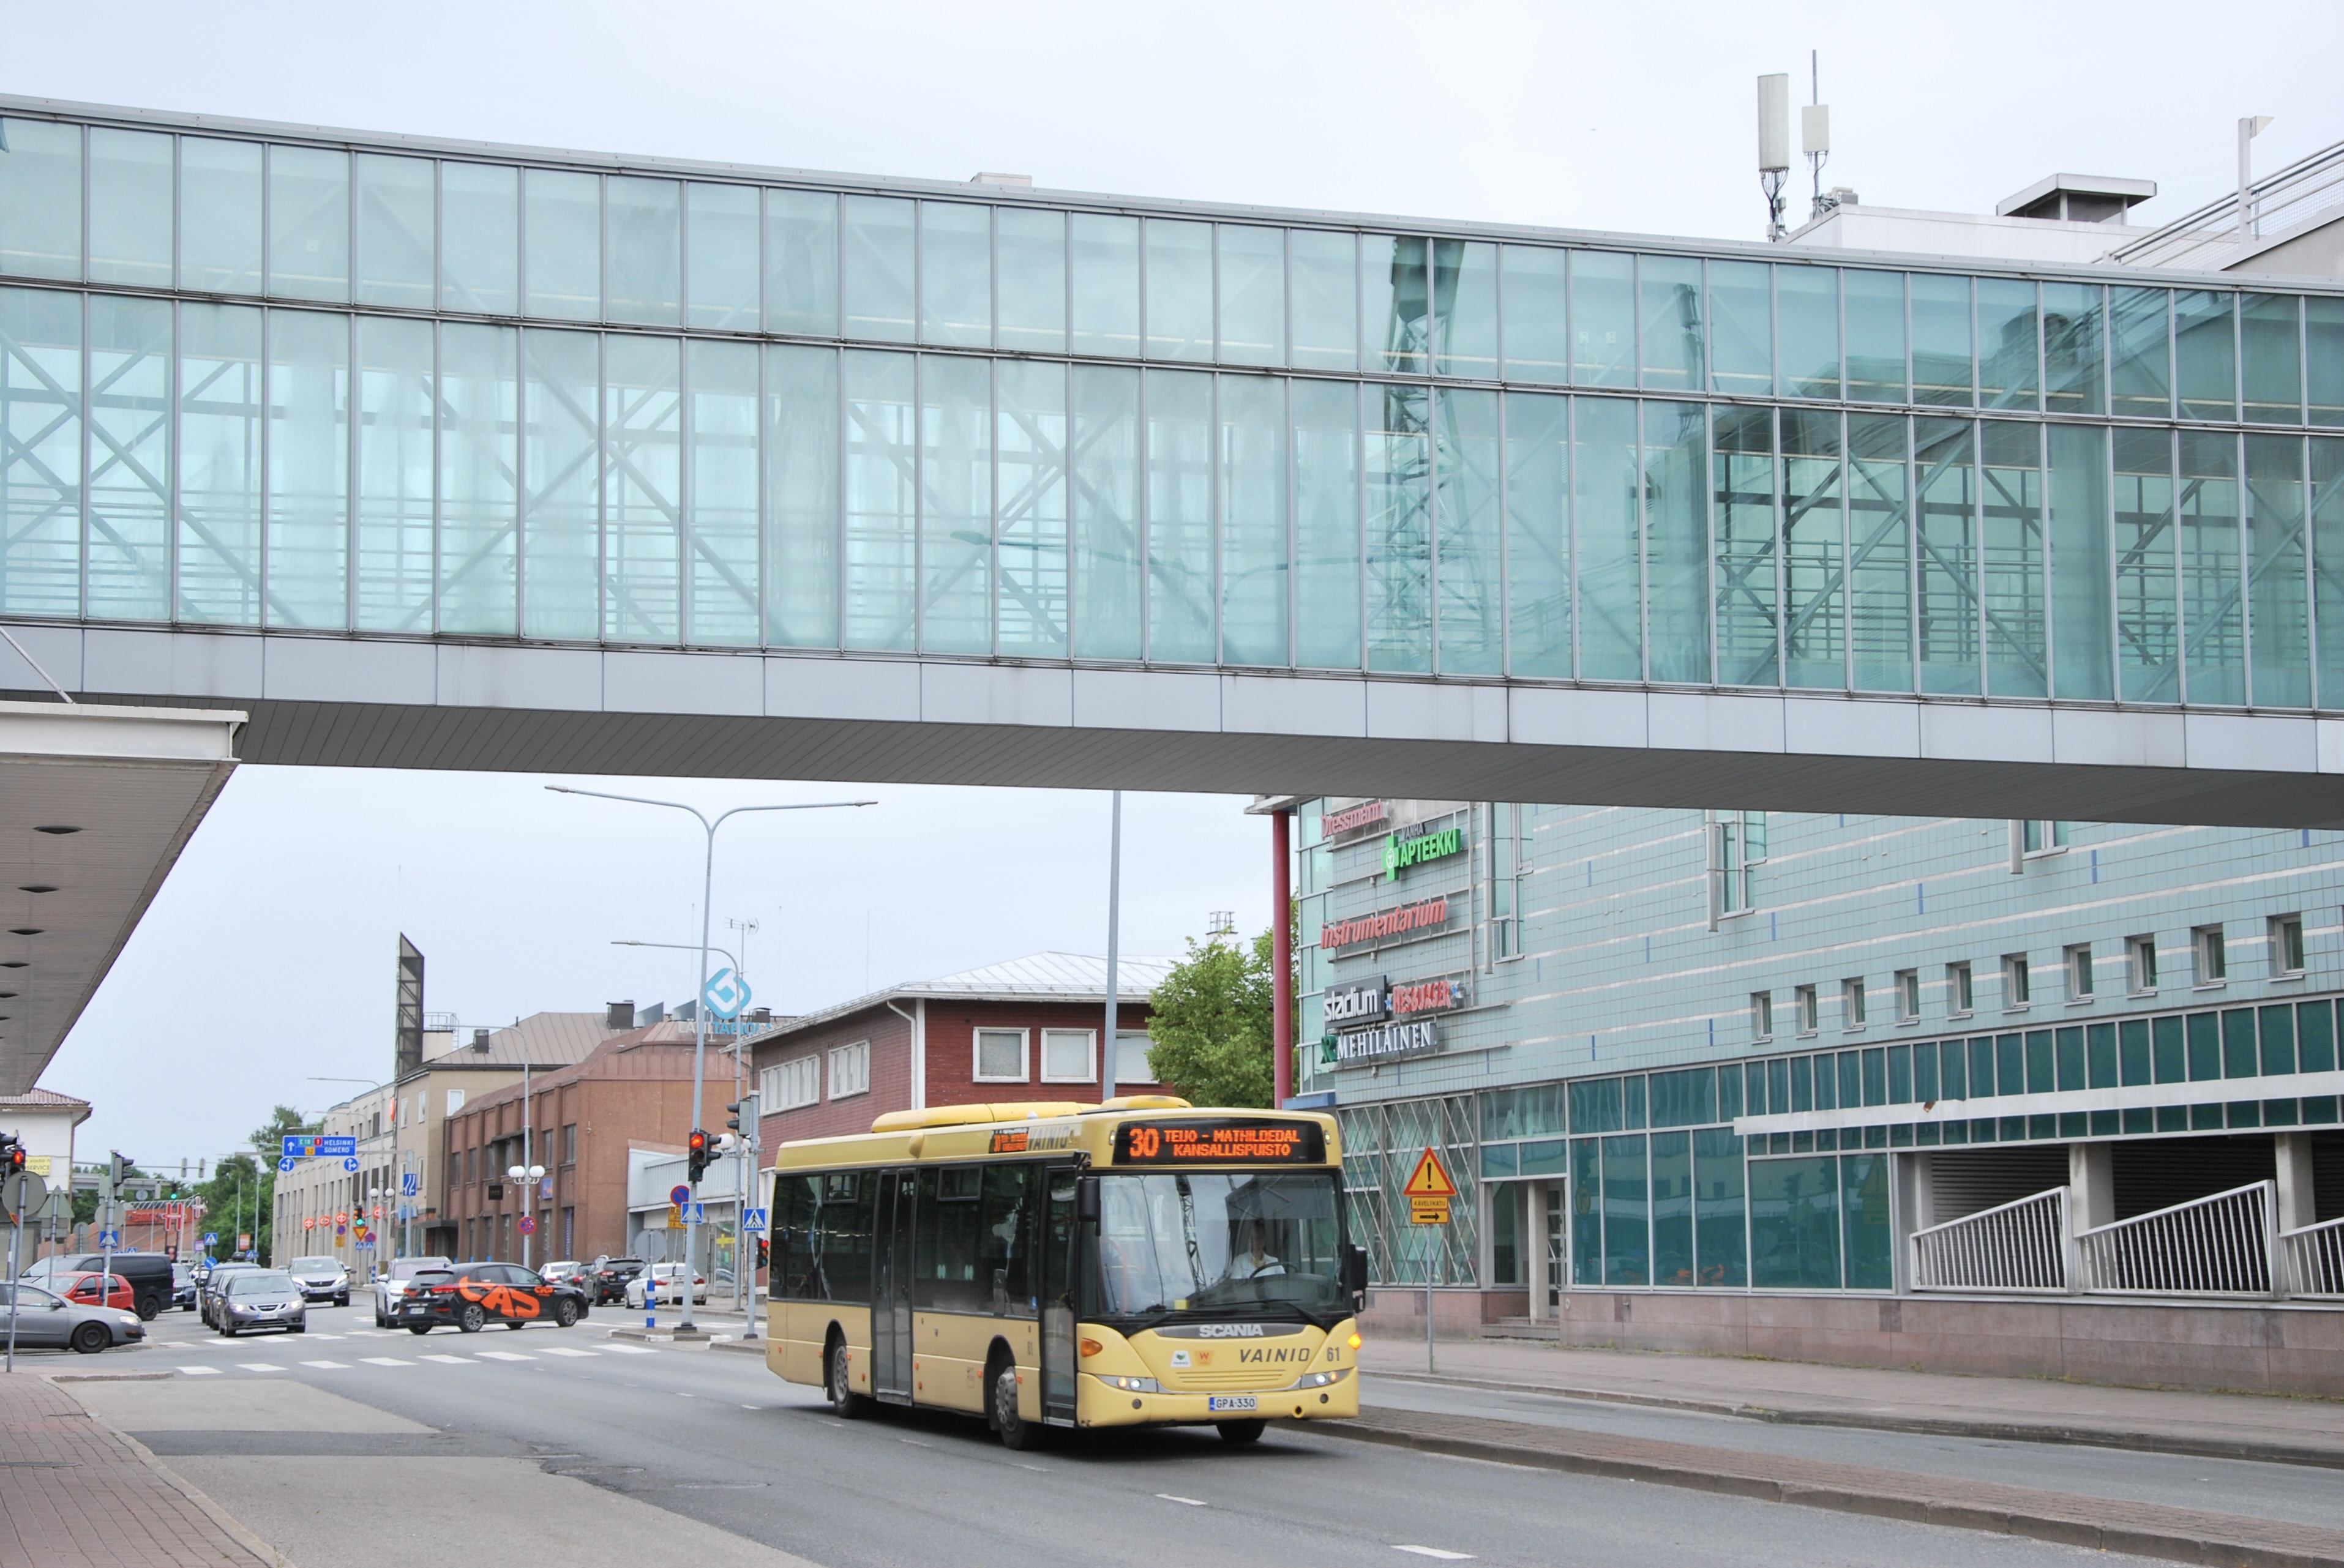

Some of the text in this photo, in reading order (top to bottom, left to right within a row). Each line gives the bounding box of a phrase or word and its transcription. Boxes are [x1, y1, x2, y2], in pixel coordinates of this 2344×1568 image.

[1321, 802, 1384, 838] Dressmann
[1402, 823, 1425, 839] VANHA
[1400, 829, 1456, 867] APTEEKKI
[1320, 900, 1445, 949] instrumentarium
[1325, 980, 1451, 1021] stadium HESBURGER
[1337, 1022, 1431, 1059] MEHILÄINEN
[1029, 1126, 1069, 1151] VAINIO
[1129, 1129, 1159, 1156] 30
[1164, 1130, 1197, 1142] TEIJO
[1213, 1130, 1301, 1143] MATHILDEDAL
[1174, 1143, 1292, 1156] KANSALLISPUISTO
[1199, 1324, 1264, 1337] SCANIA
[1240, 1347, 1339, 1362] VAINIO 61
[1216, 1398, 1255, 1408] GPA-330
